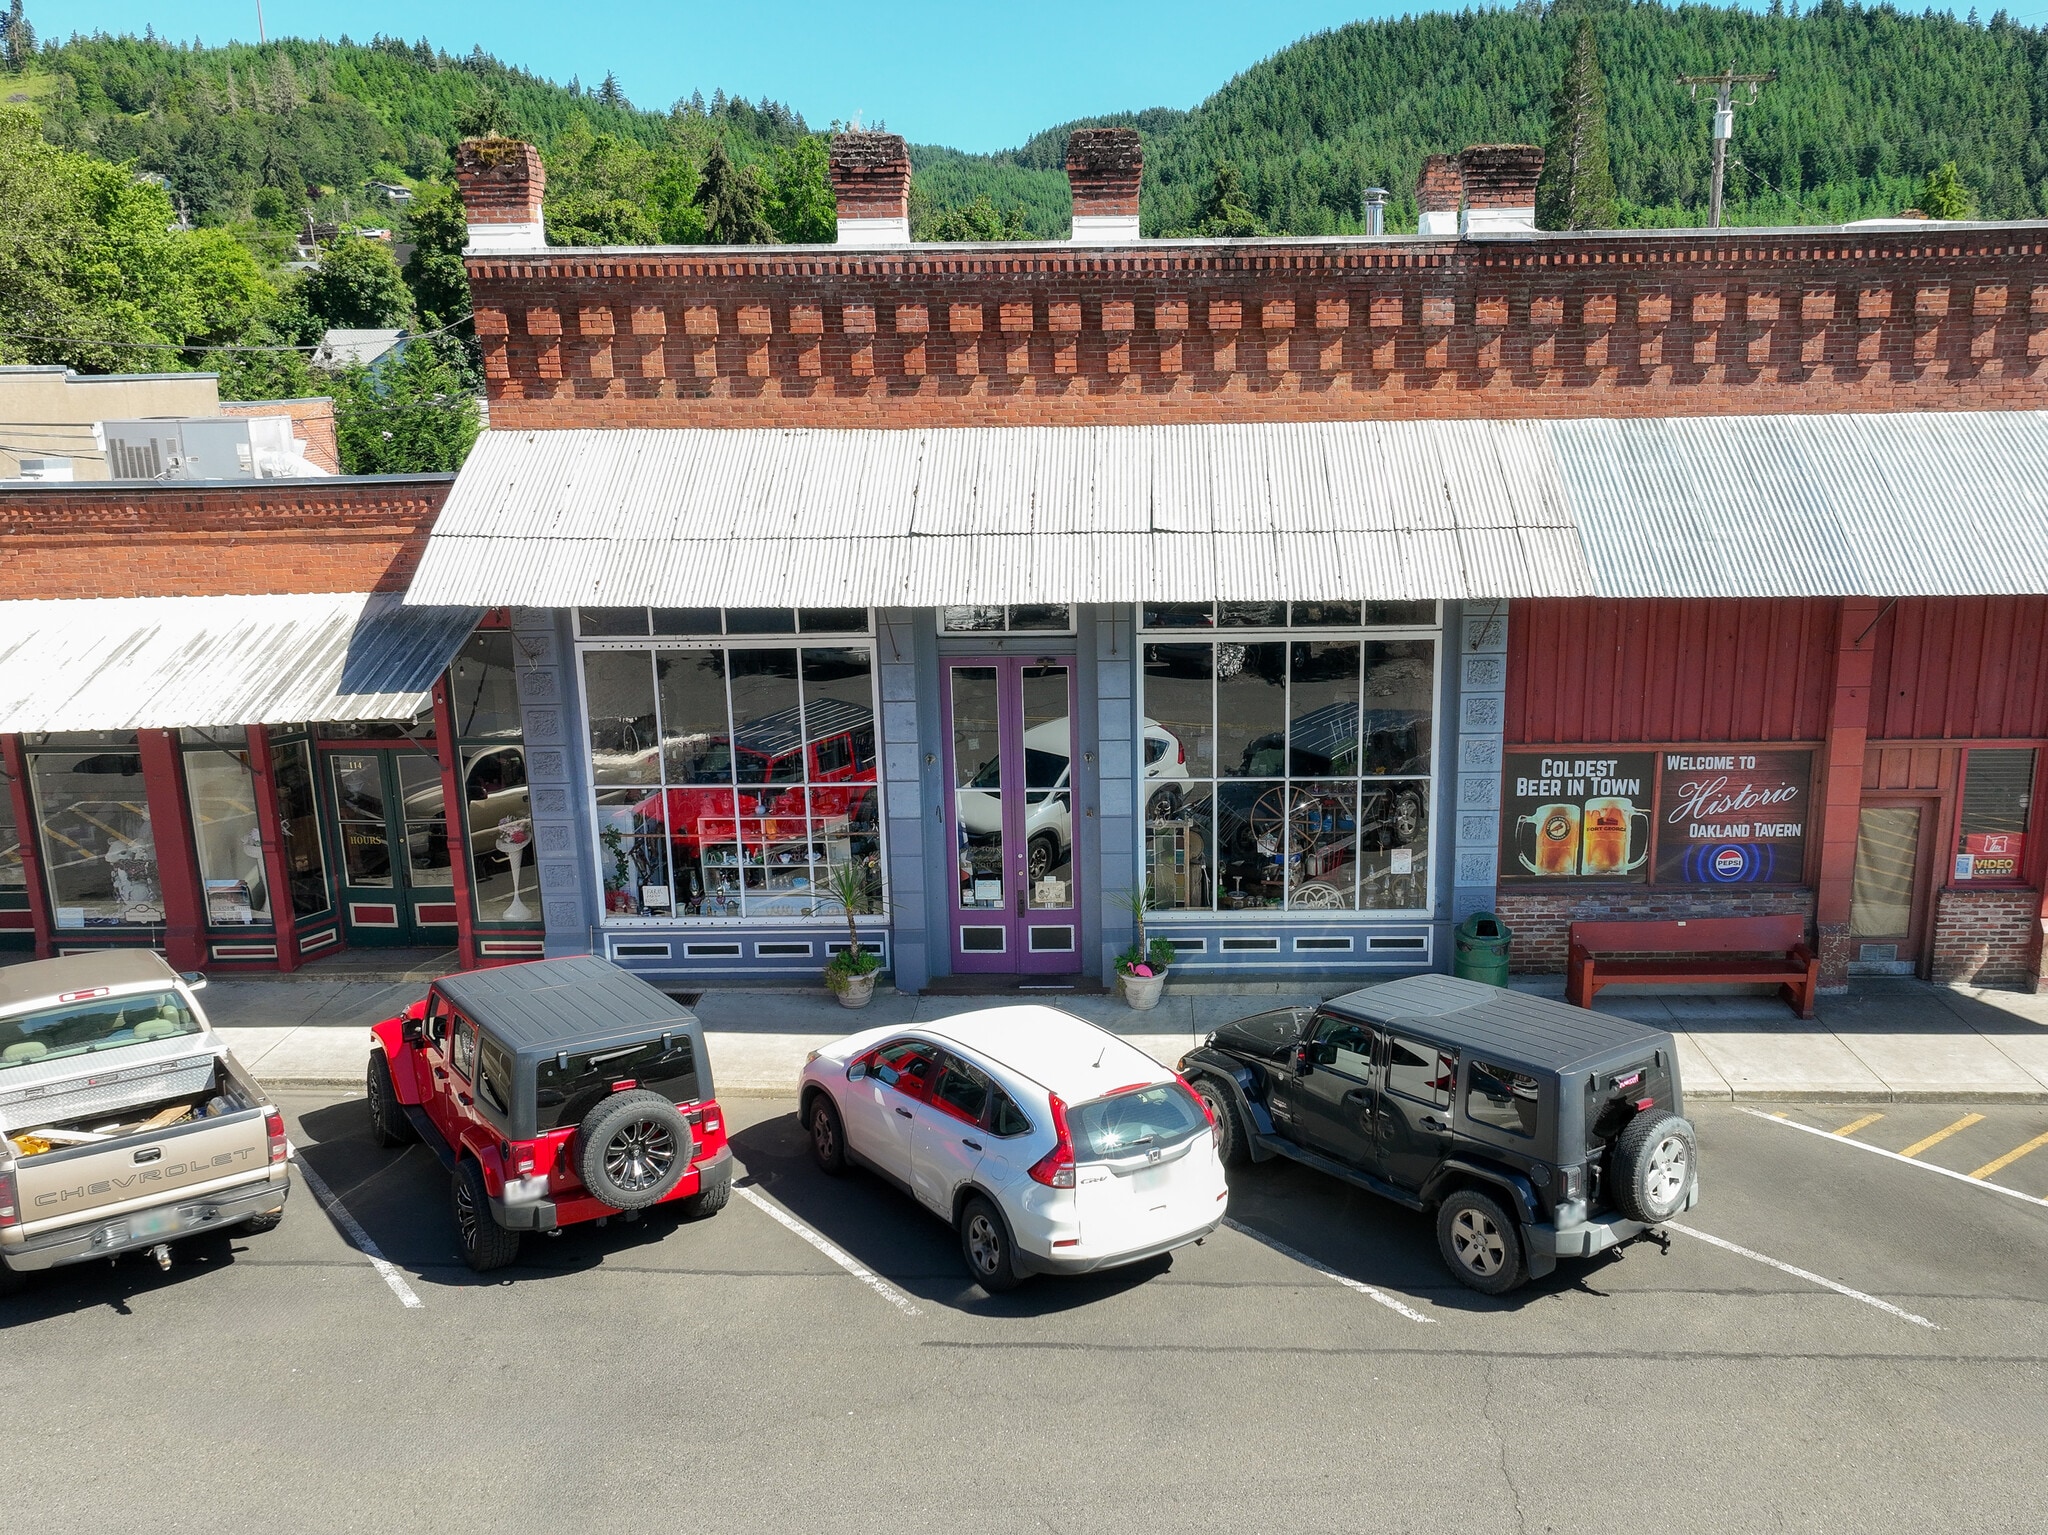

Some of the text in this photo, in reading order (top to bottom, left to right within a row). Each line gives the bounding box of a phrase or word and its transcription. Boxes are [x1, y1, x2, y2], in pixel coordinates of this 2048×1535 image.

[349, 761, 362, 769] 114
[1541, 758, 1618, 778] COLDEST
[1667, 755, 1756, 771] WELCOME TO
[1516, 777, 1640, 796] BEER IN TOWN
[1668, 776, 1799, 824] Historic
[1689, 822, 1802, 838] OAKLAND TAVERN
[350, 836, 382, 845] HOURS
[1975, 859, 2014, 869] VIDEO
[34, 1147, 256, 1207] CHEVROLET
